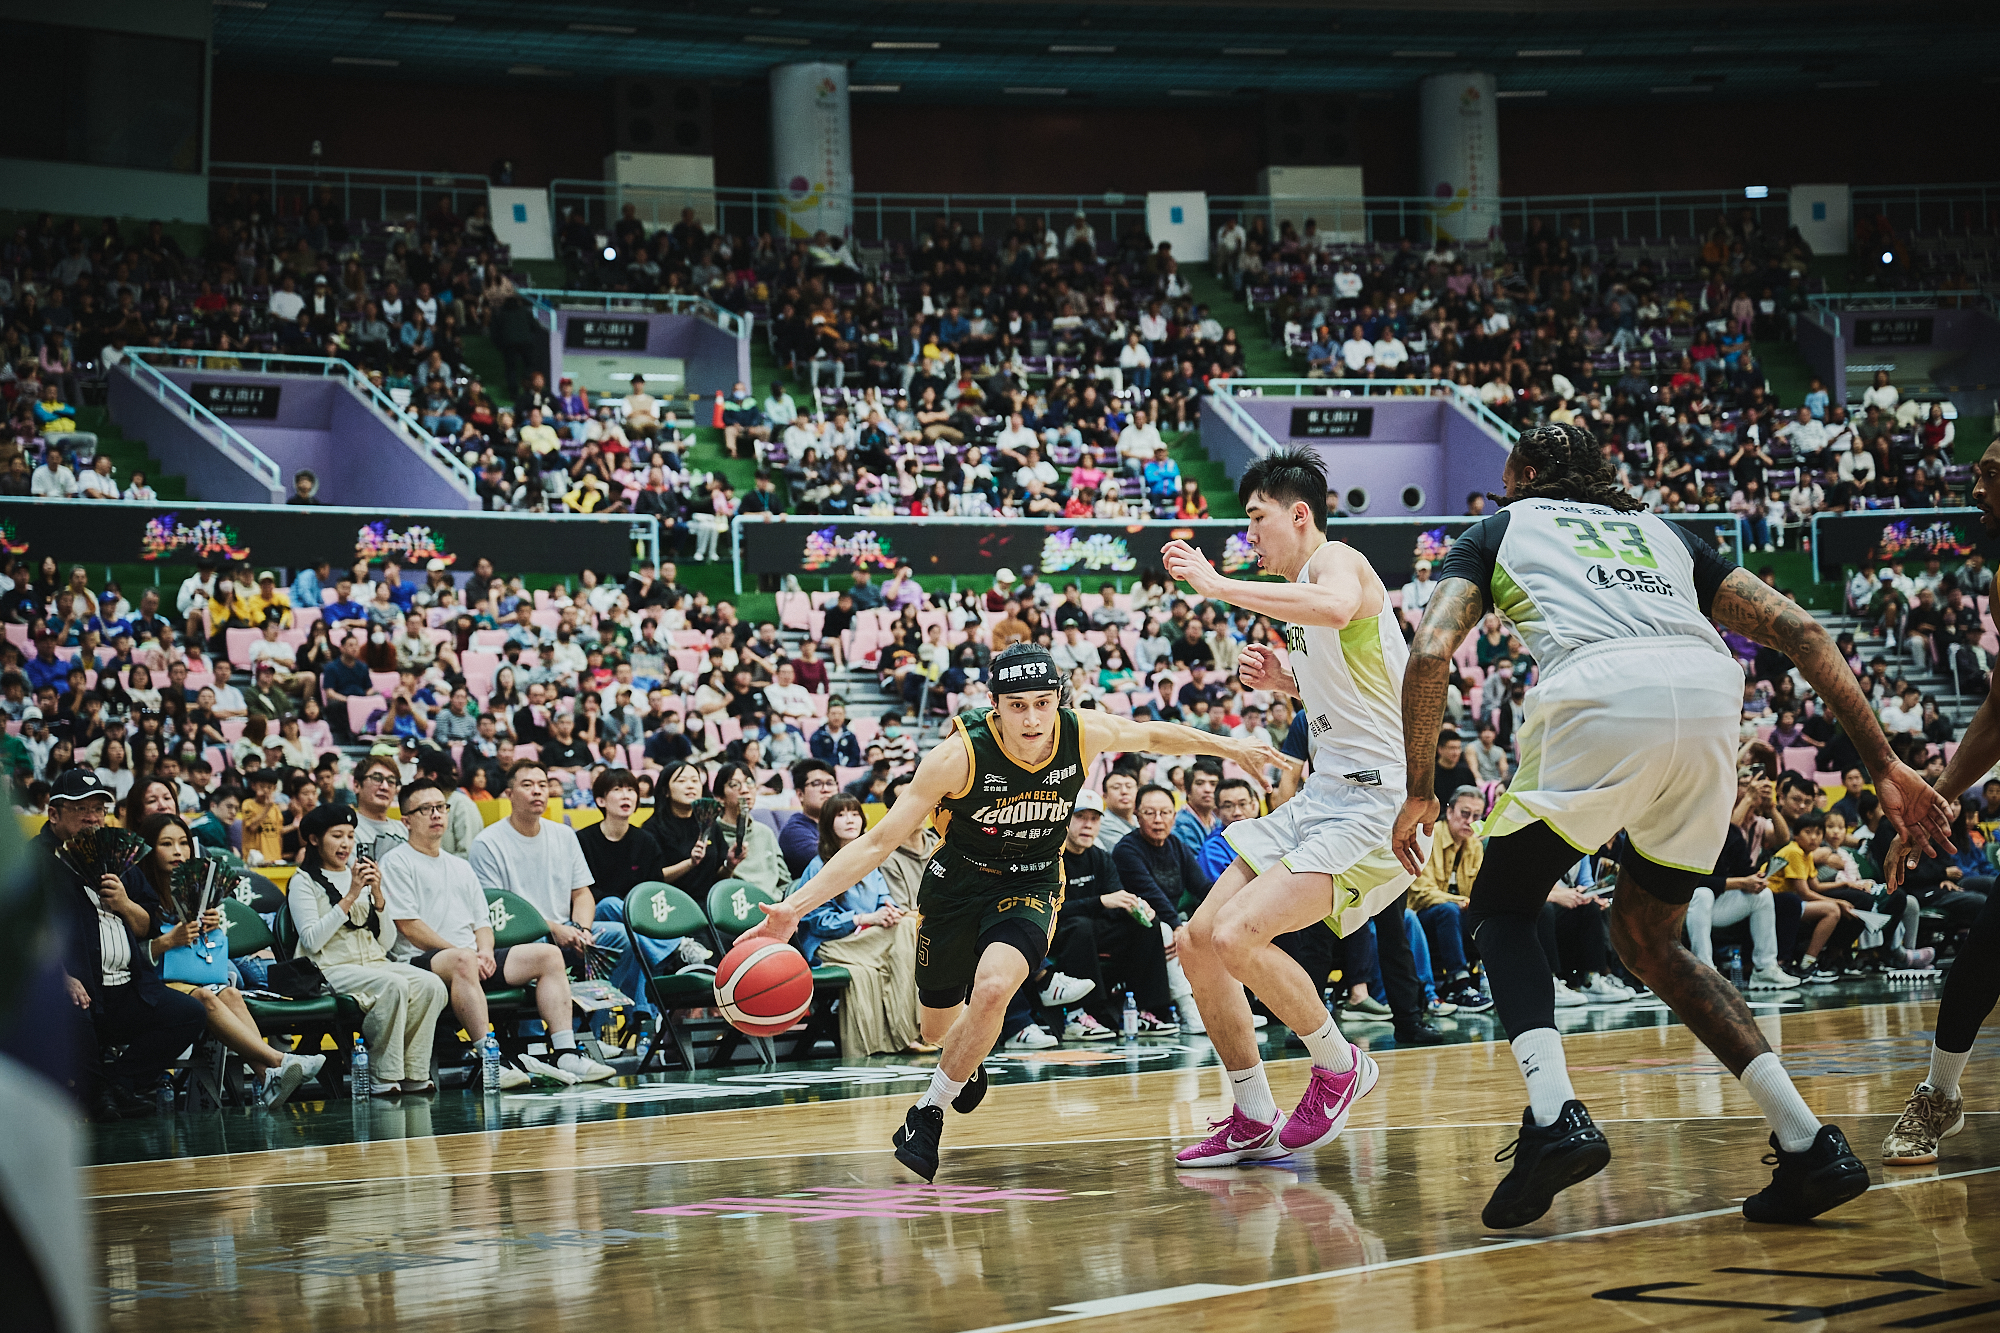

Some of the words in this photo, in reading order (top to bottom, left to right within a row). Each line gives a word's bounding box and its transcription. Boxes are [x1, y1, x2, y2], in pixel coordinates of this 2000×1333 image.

[1553, 516, 1659, 570] 33
[995, 790, 1033, 809] TAIWAN
[1033, 790, 1058, 801] BEER
